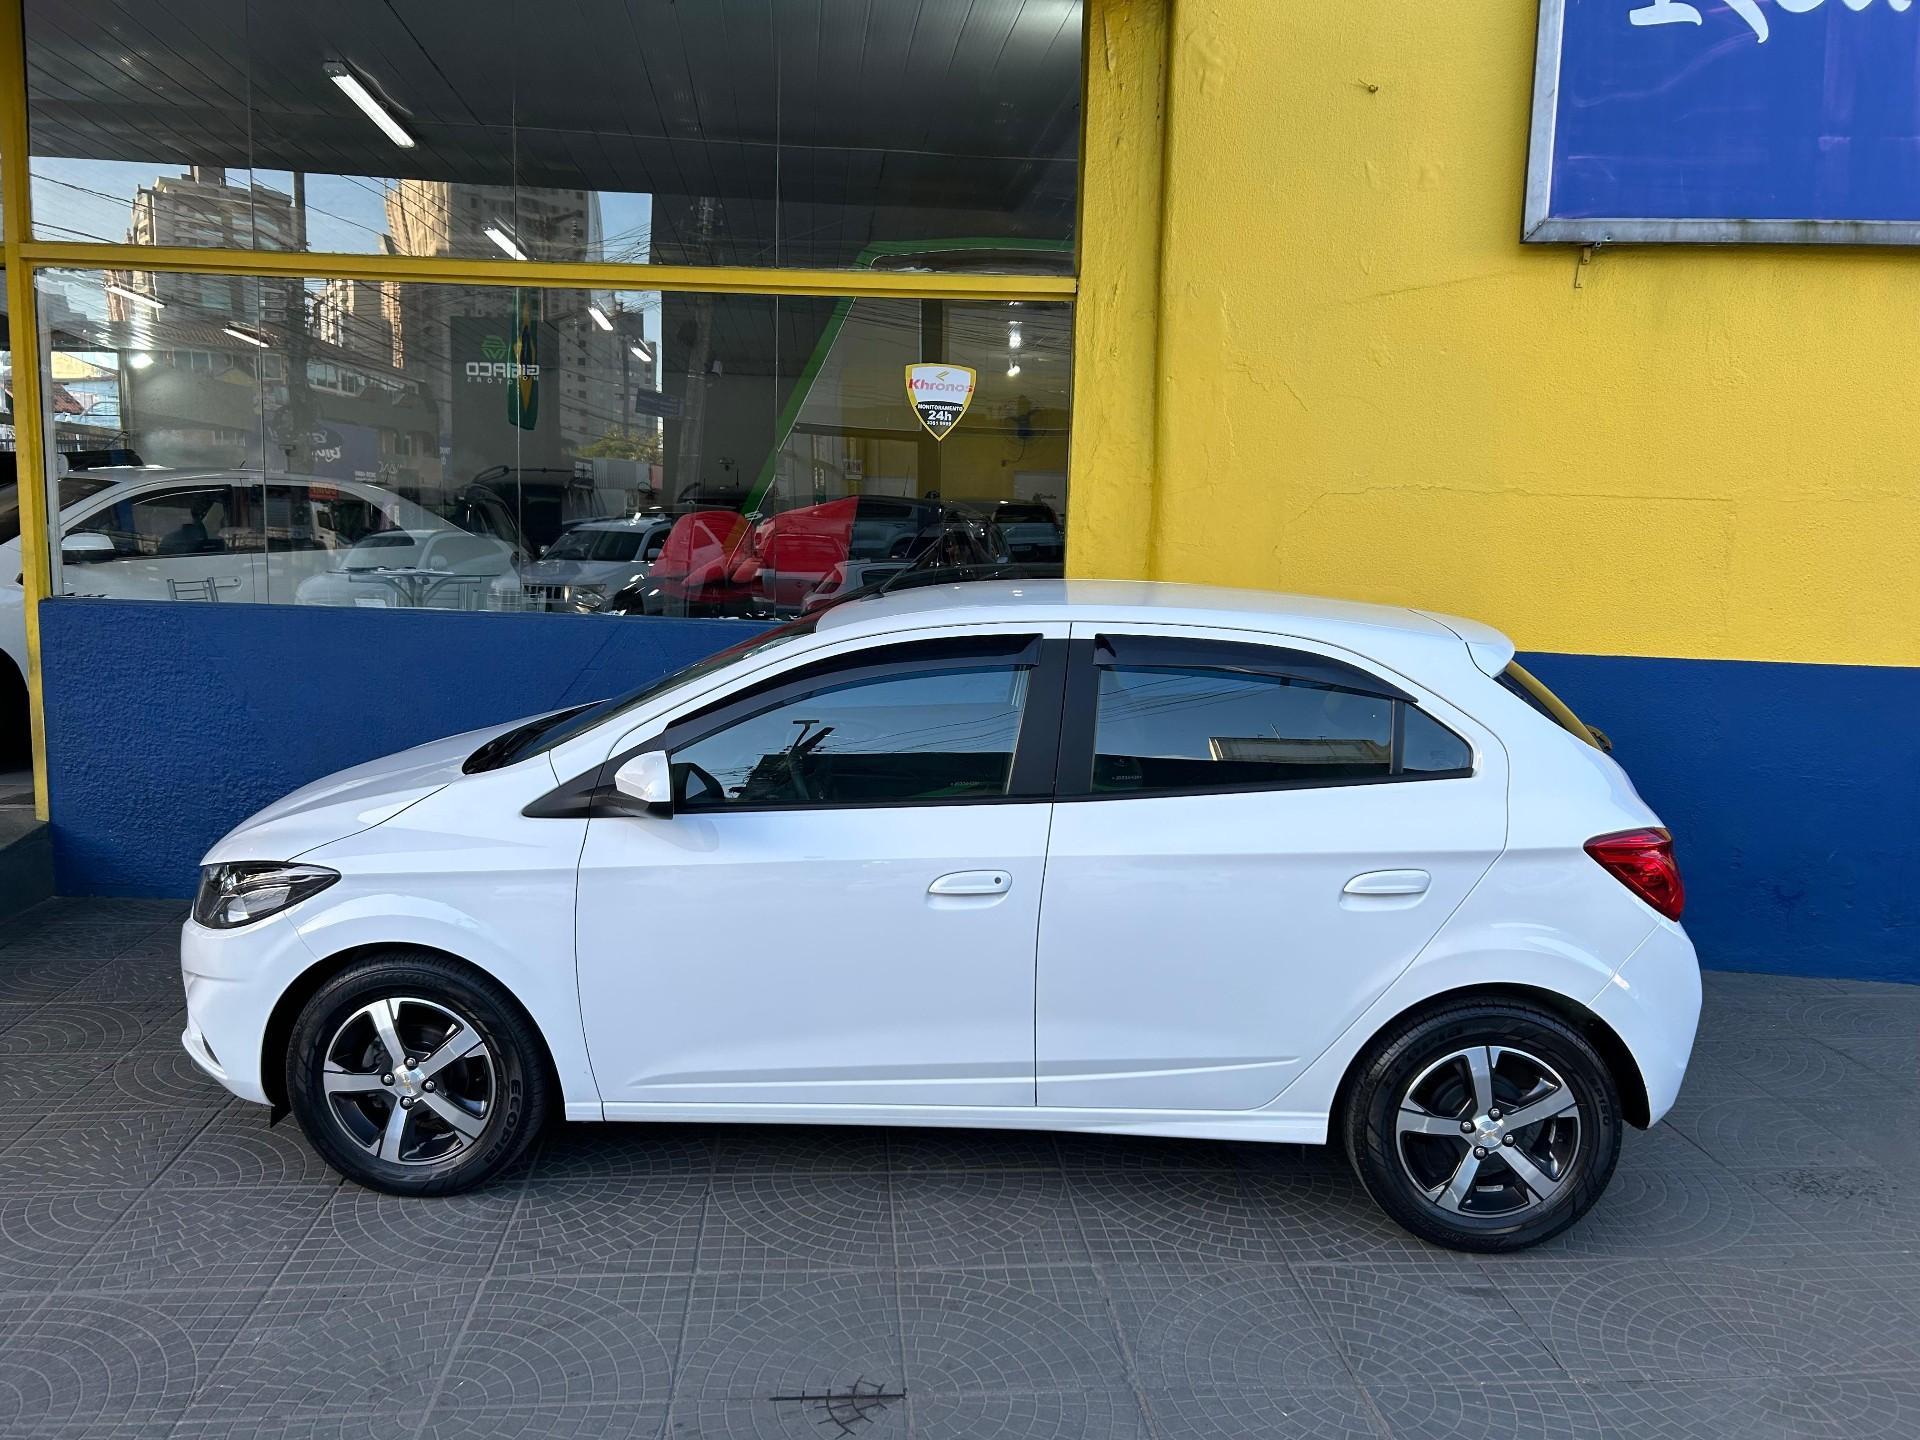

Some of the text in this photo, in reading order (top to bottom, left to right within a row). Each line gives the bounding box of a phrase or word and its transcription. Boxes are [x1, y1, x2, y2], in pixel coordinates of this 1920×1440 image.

[908, 378, 975, 393] Khronos
[917, 404, 963, 412] MONITORAMENTO
[928, 410, 952, 421] 24h
